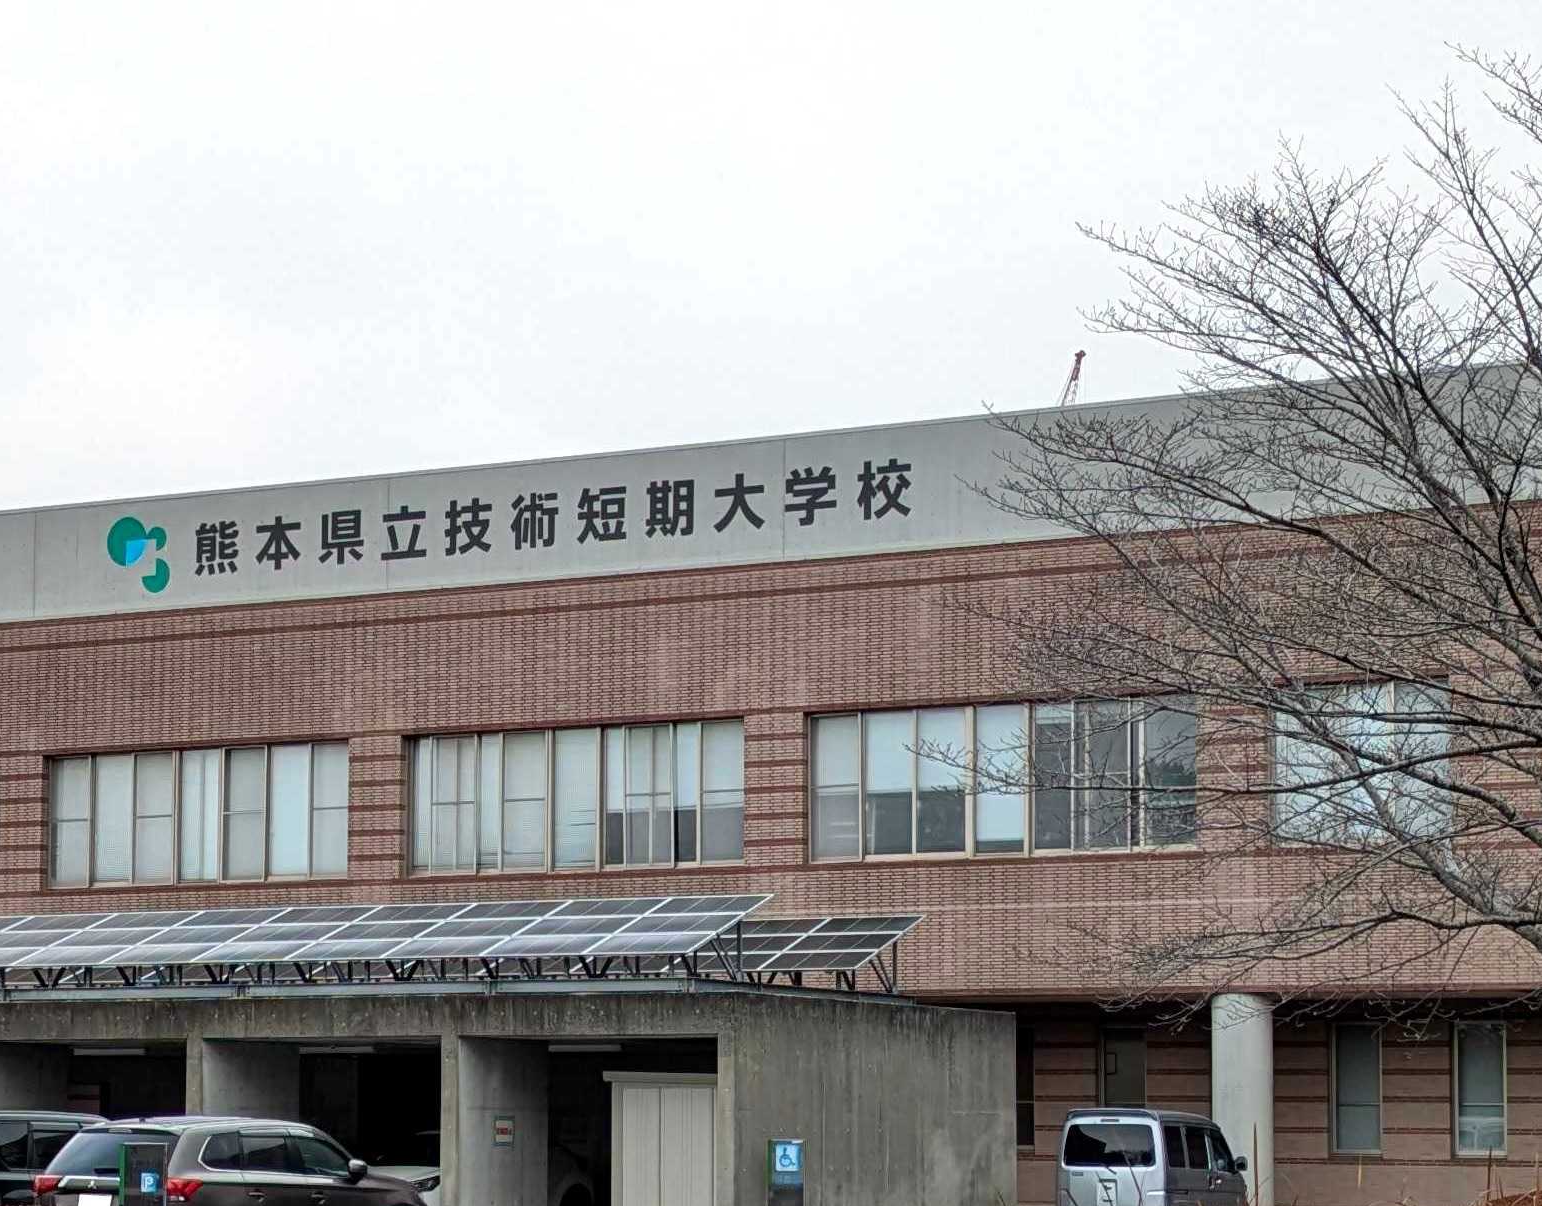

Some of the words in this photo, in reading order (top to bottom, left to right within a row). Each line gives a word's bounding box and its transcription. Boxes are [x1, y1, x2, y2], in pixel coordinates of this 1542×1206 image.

[194, 459, 913, 576] 熊本県立技術短期大学校
